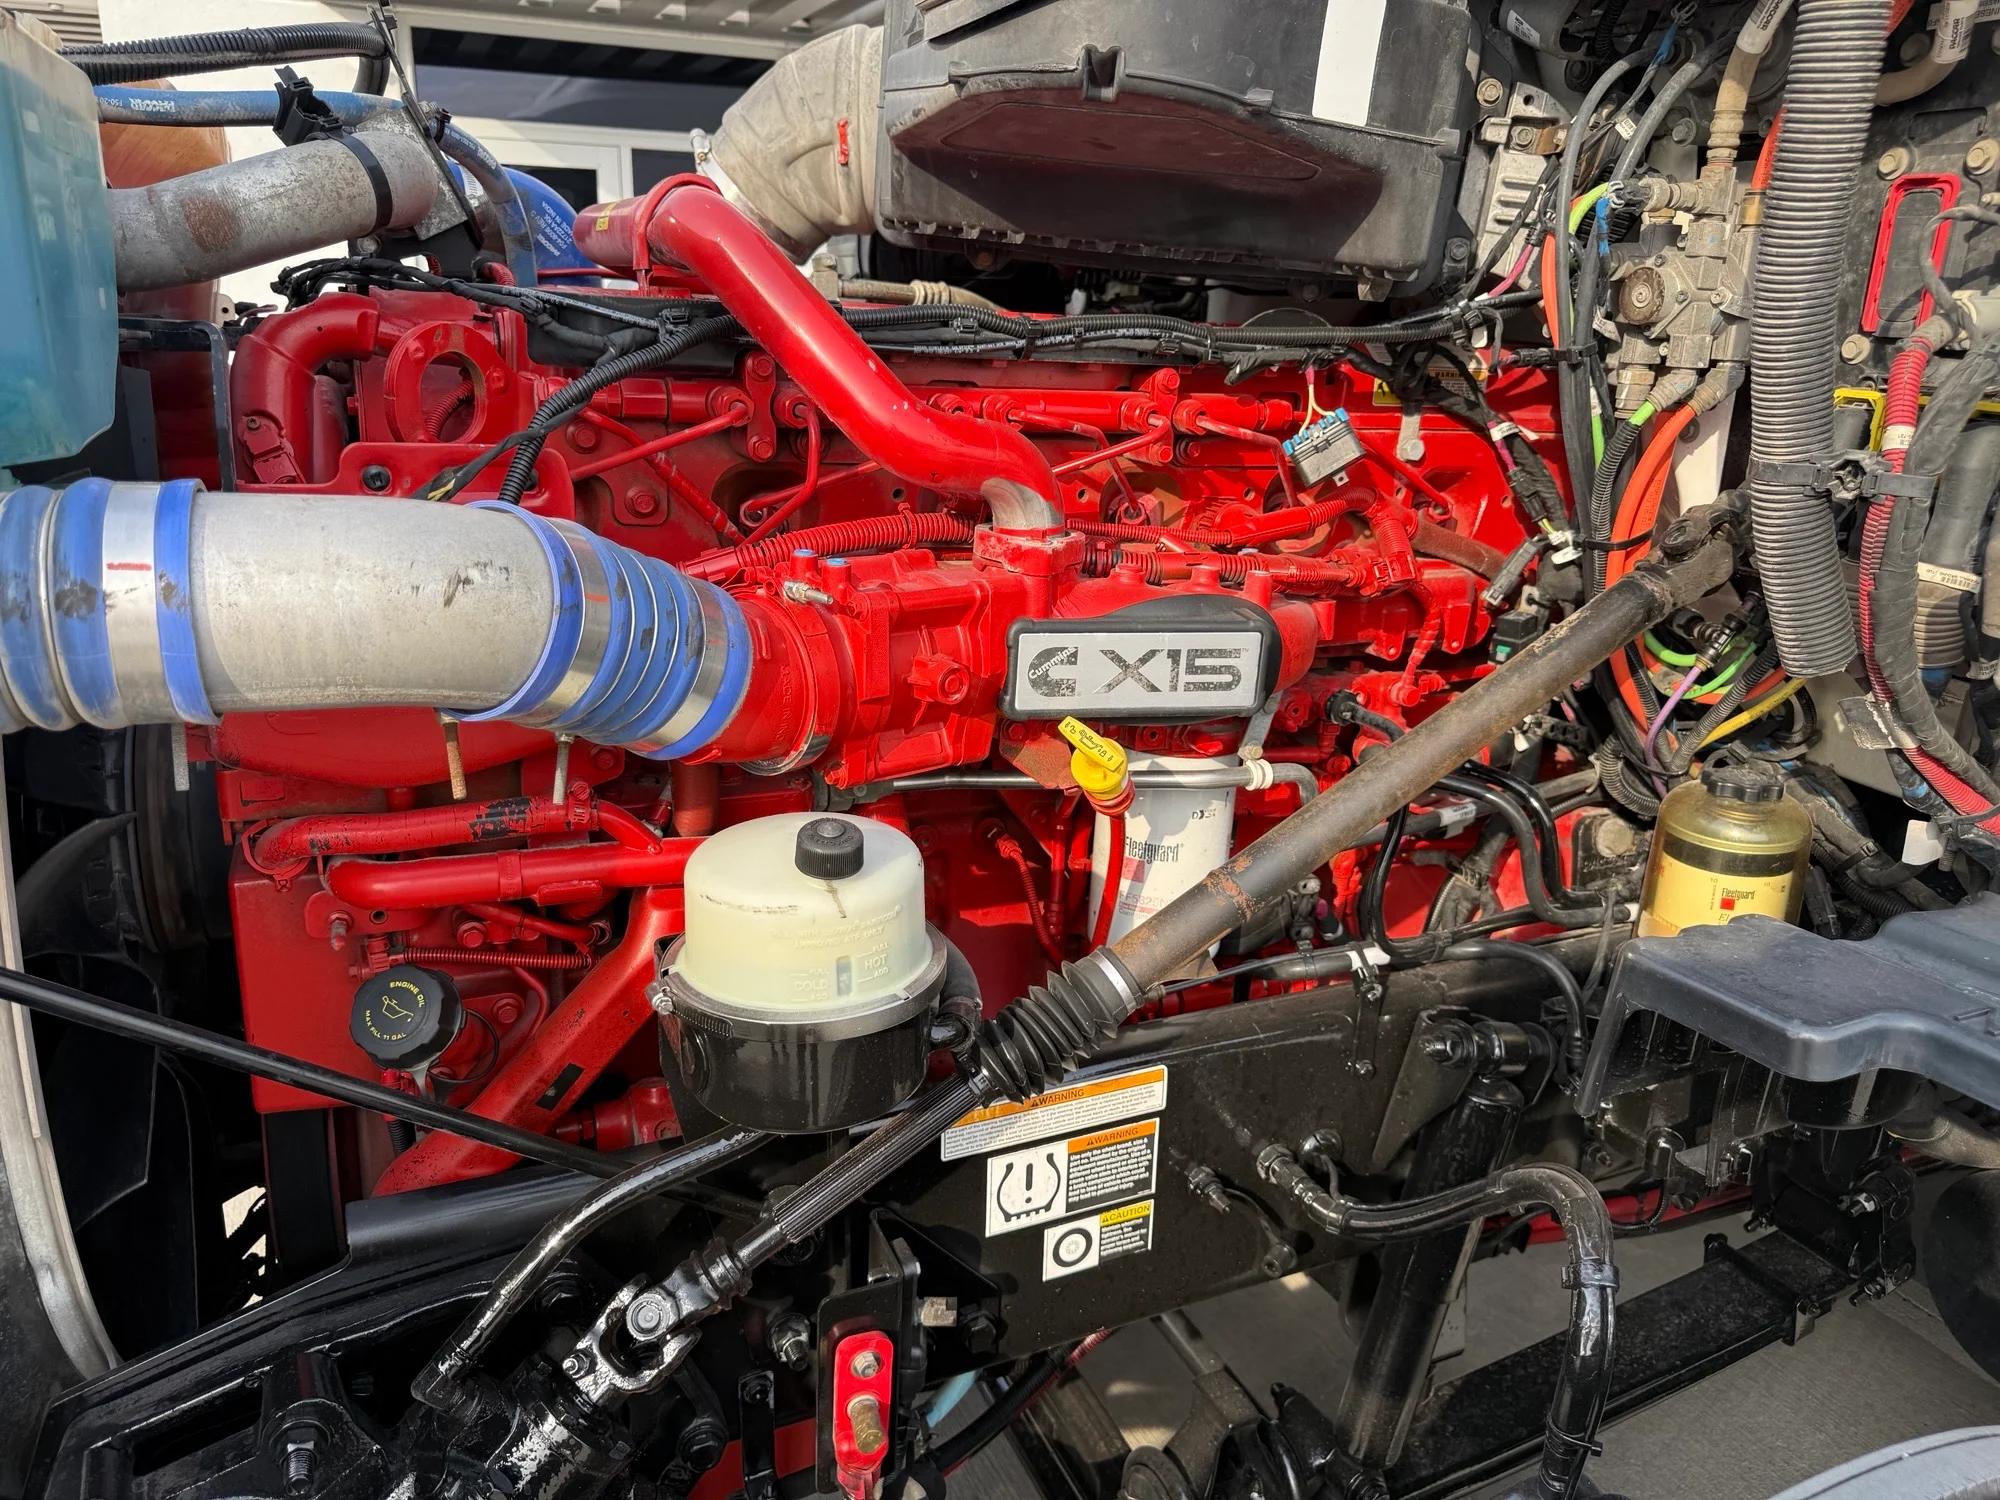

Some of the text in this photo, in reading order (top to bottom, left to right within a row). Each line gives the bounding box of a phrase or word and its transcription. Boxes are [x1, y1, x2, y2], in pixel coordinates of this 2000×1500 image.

[1029, 646, 1078, 680] Cummins
[1093, 647, 1243, 694] X15
[864, 953, 888, 970] HOT
[389, 981, 426, 1008] ENGINE OIL
[365, 1010, 373, 1027] MAX
[369, 1026, 382, 1039] FILL
[391, 1032, 407, 1041] GAL
[1039, 1088, 1085, 1105] WARNING
[1094, 1127, 1139, 1145] WARNING
[1110, 1204, 1150, 1221] CAUTION
